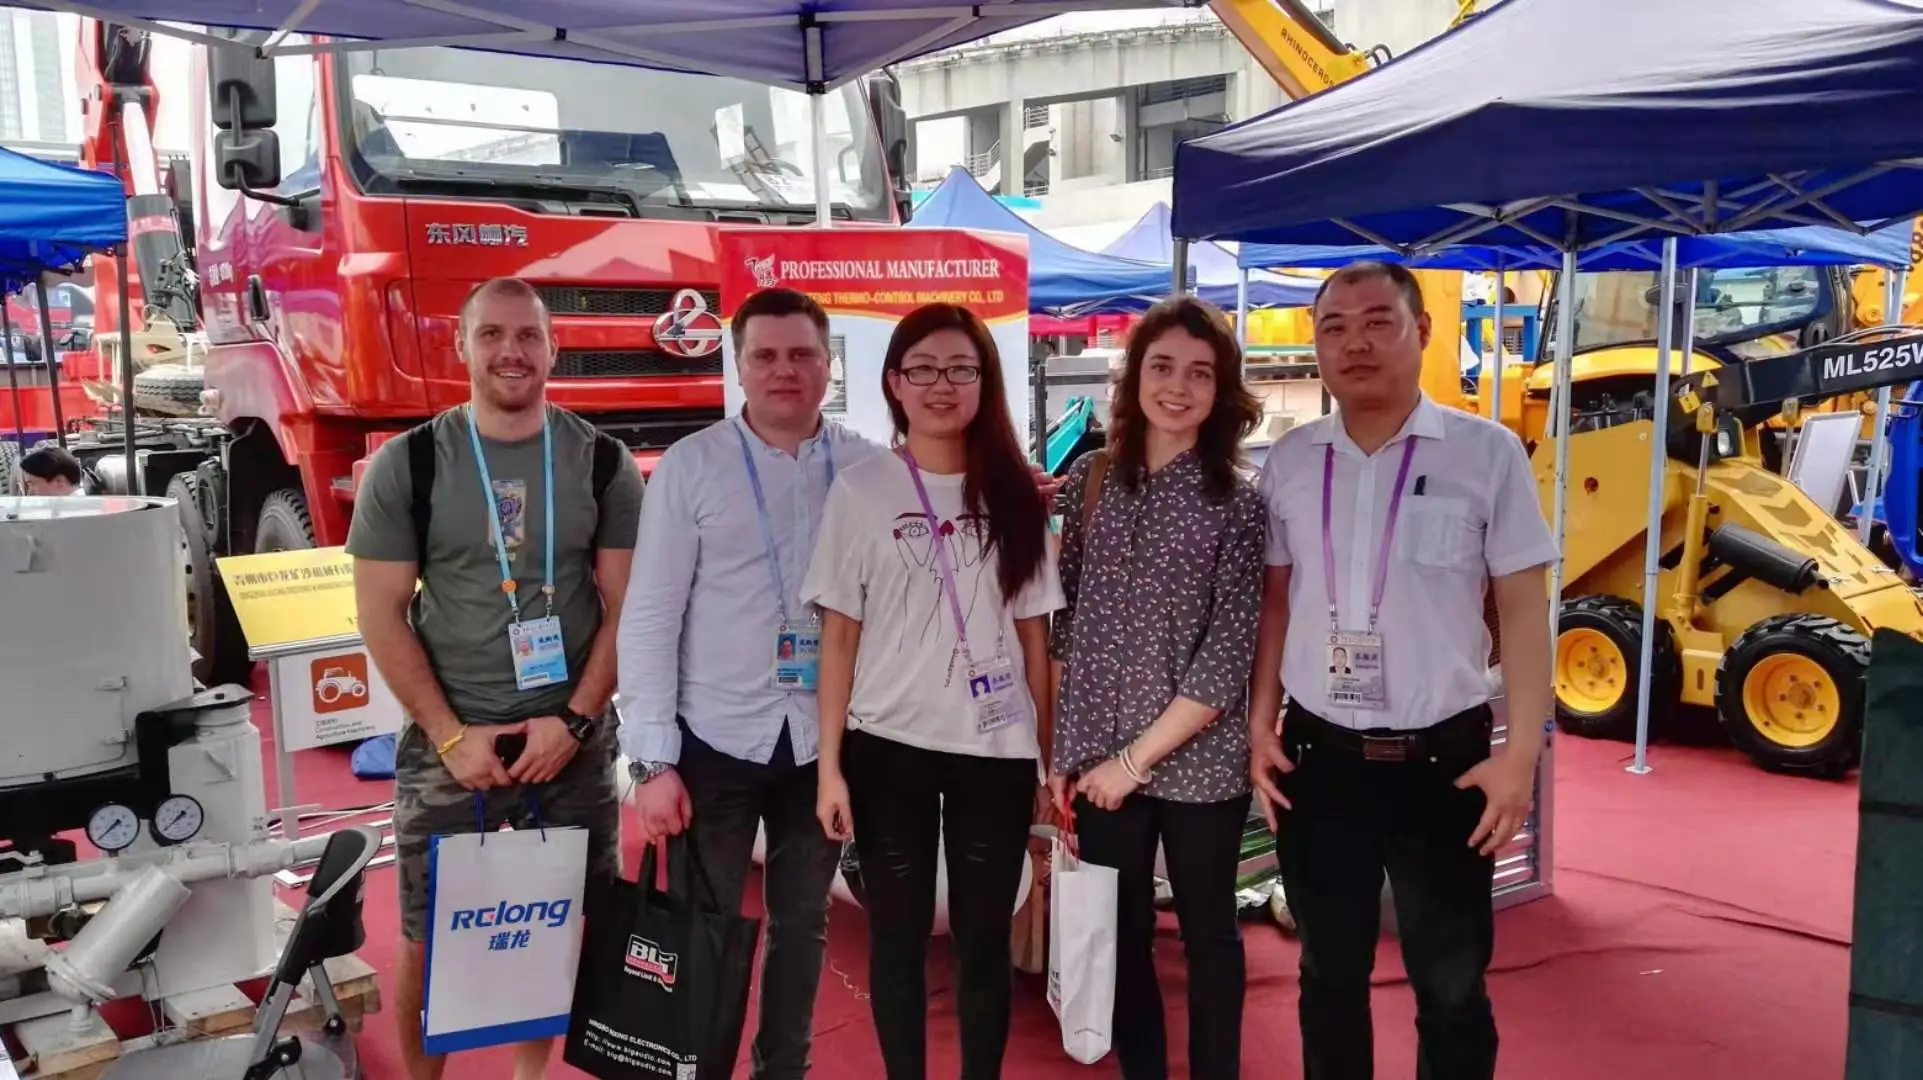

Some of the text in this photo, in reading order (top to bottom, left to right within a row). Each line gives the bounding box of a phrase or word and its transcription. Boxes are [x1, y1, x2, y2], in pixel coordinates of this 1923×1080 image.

[780, 258, 999, 280] PROFESSIONAL MANUFACTURER
[488, 929, 531, 951] 瑞龙
